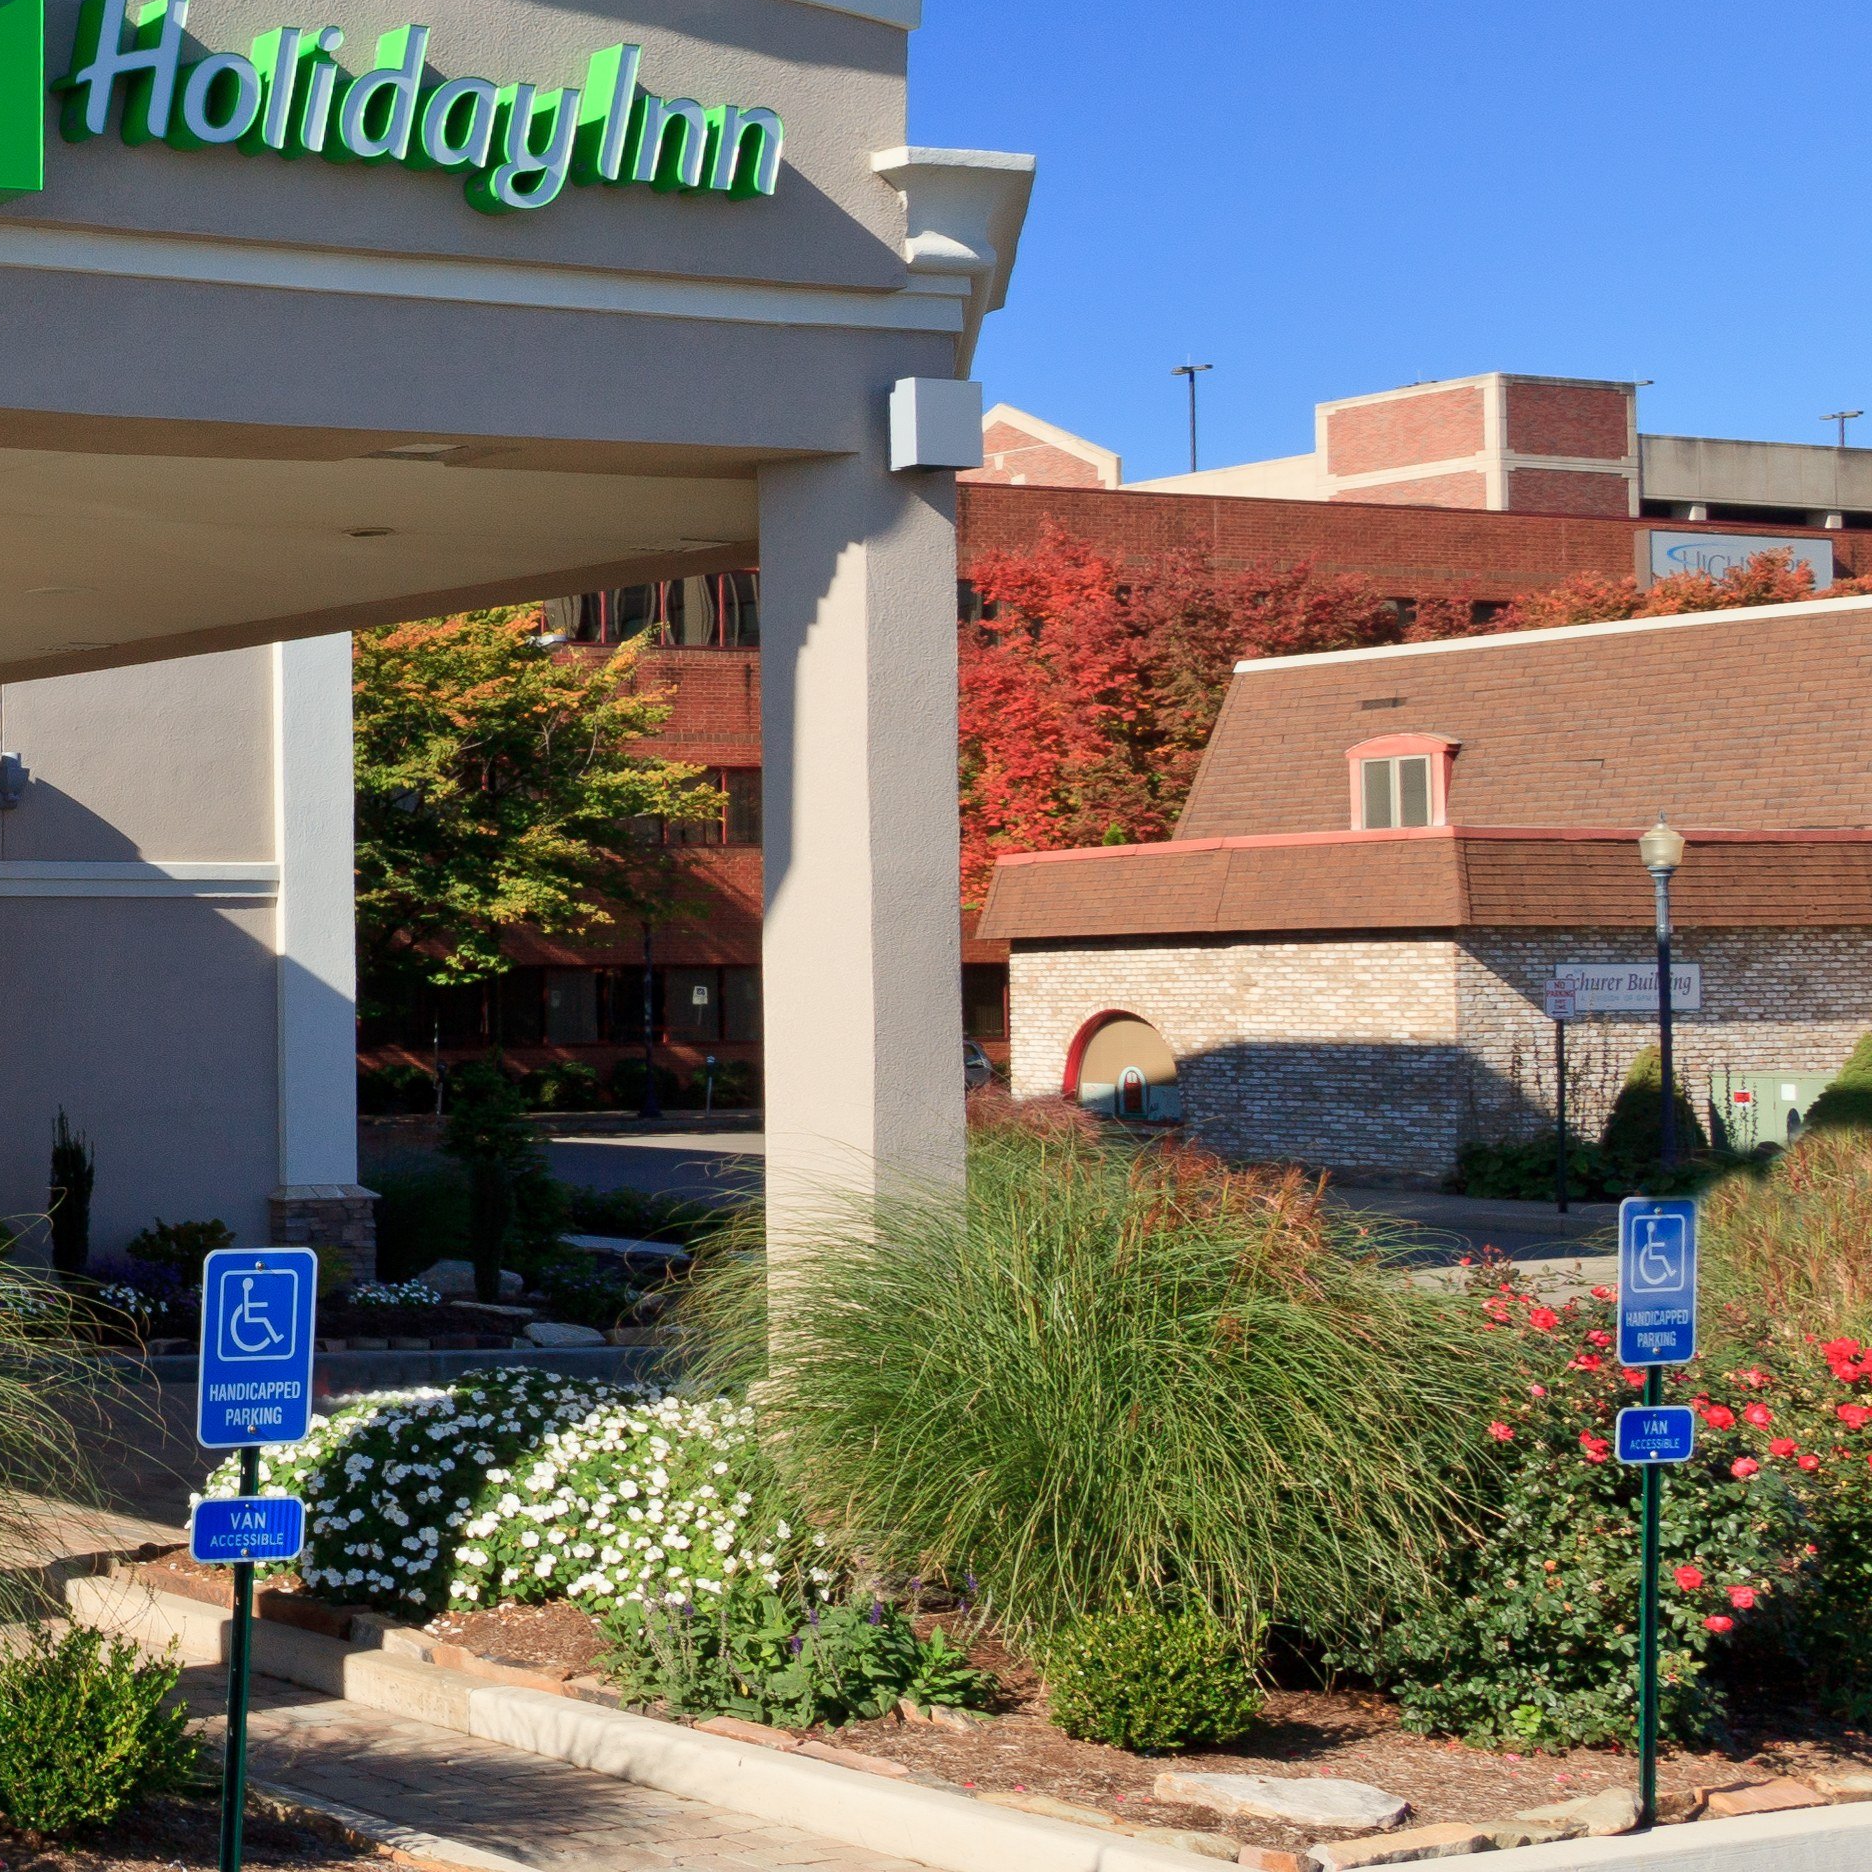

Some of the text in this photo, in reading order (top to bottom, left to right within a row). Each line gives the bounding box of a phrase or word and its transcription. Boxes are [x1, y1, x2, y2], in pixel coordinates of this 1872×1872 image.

[586, 42, 784, 196] Inn
[1627, 972, 1692, 996] Builing
[1625, 1309, 1689, 1327] HANDICAPPED
[1636, 1331, 1677, 1347] PARKING
[209, 1380, 301, 1402] HANDICAPPED
[225, 1406, 283, 1427] PARKING
[1643, 1420, 1668, 1434] VAN
[1630, 1437, 1680, 1449] ACCESSIBLE
[230, 1512, 267, 1529] VAN
[209, 1532, 285, 1547] ACCESSIBLE
